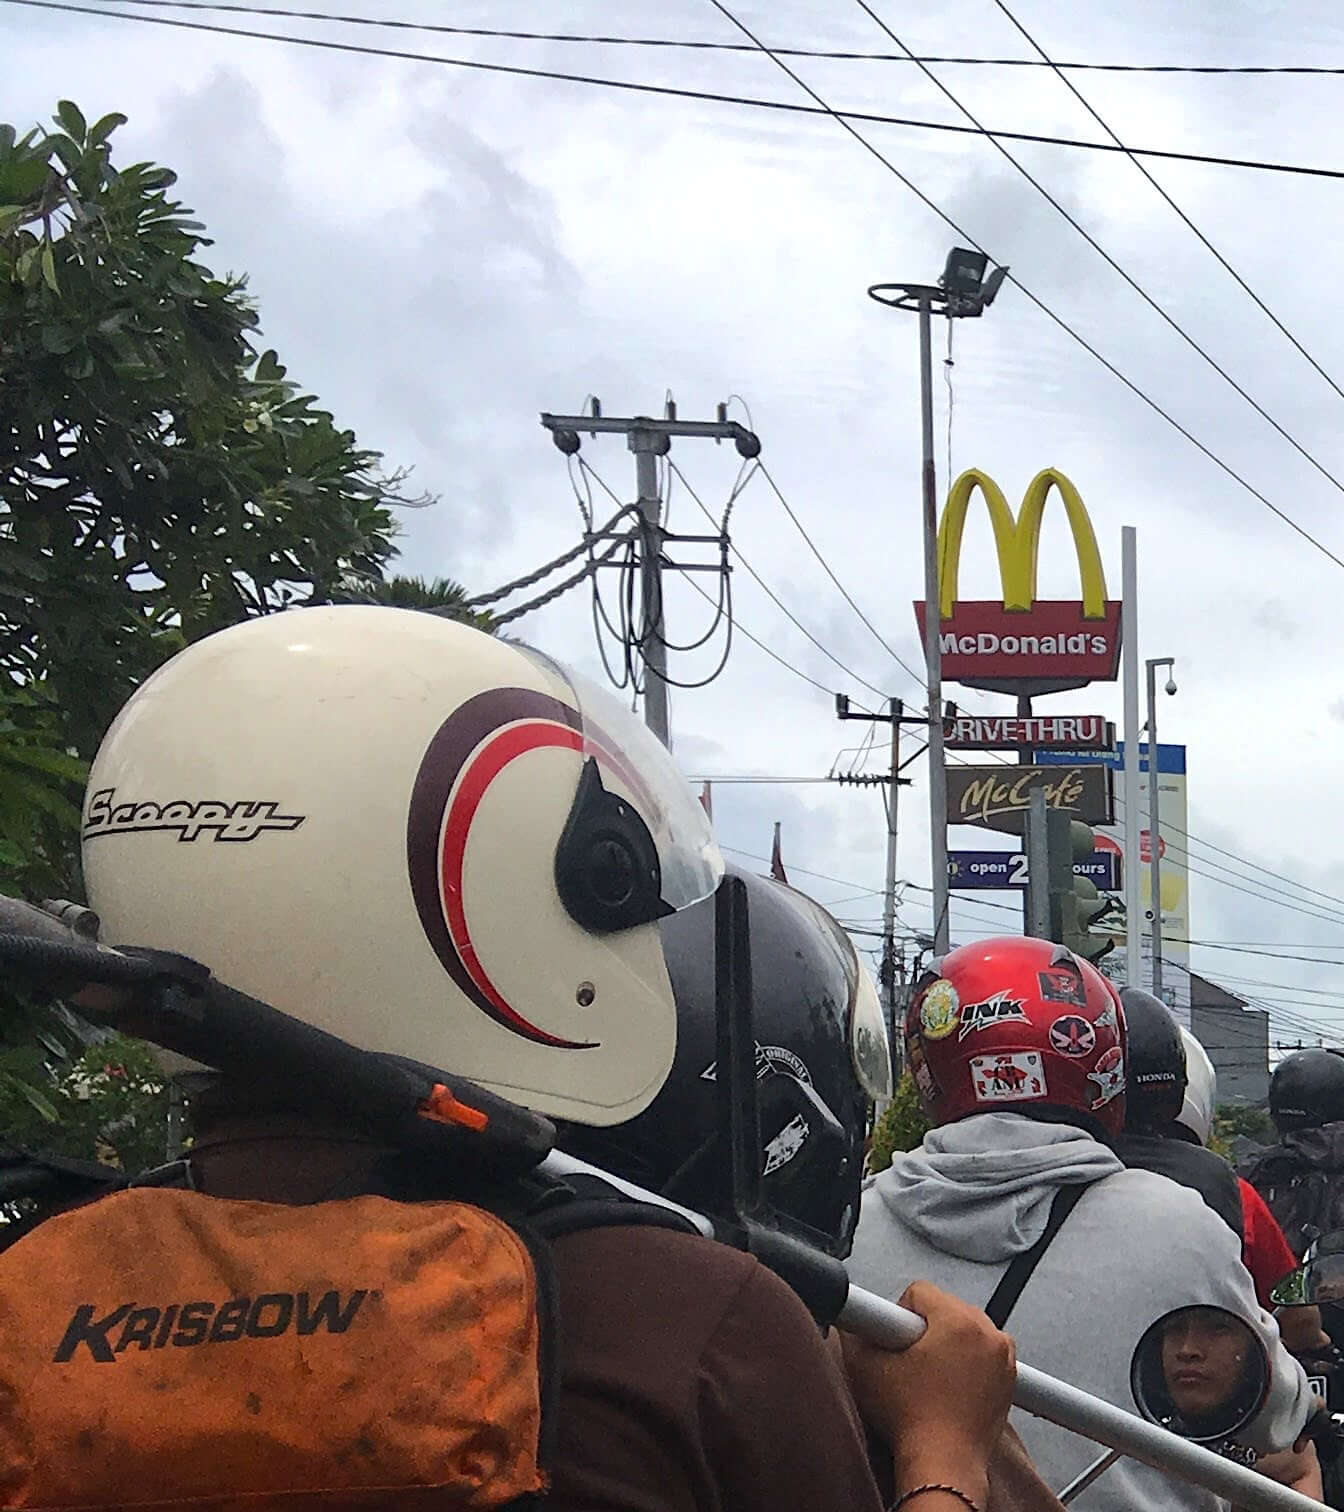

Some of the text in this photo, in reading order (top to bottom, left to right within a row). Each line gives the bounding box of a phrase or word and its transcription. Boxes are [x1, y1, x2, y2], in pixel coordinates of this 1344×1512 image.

[939, 633, 1107, 655] McDonald's
[83, 787, 305, 842] Scoopy
[970, 855, 1106, 884] open 2 ours
[961, 1001, 1022, 1020] INK
[766, 1049, 807, 1081] ORIGINAL
[1137, 1072, 1176, 1083] HONDA
[52, 1290, 368, 1363] KRISBOW
